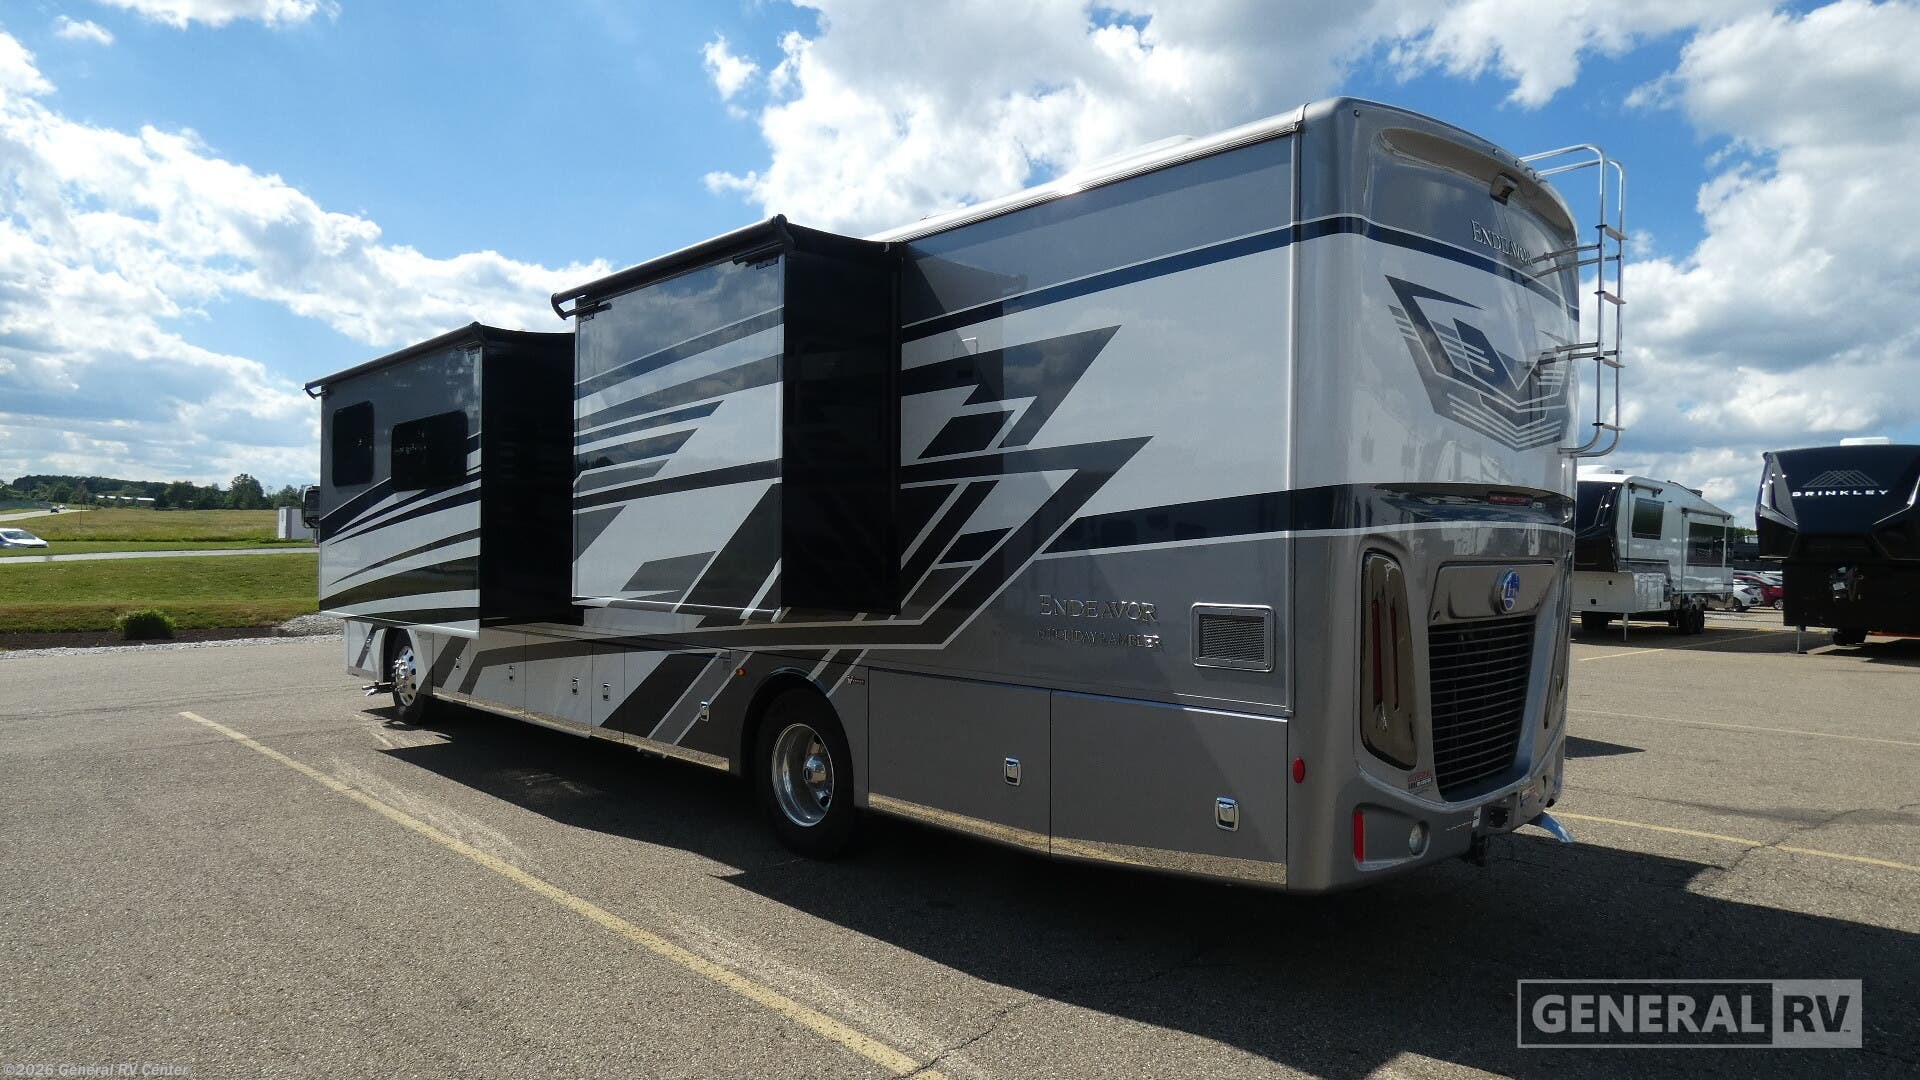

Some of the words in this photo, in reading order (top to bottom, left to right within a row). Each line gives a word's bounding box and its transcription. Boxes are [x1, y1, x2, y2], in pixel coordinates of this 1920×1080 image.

[1471, 219, 1533, 267] ENDEAVOR
[1792, 489, 1889, 497] BRINKLEY
[1039, 594, 1158, 622] ENDEAVOR
